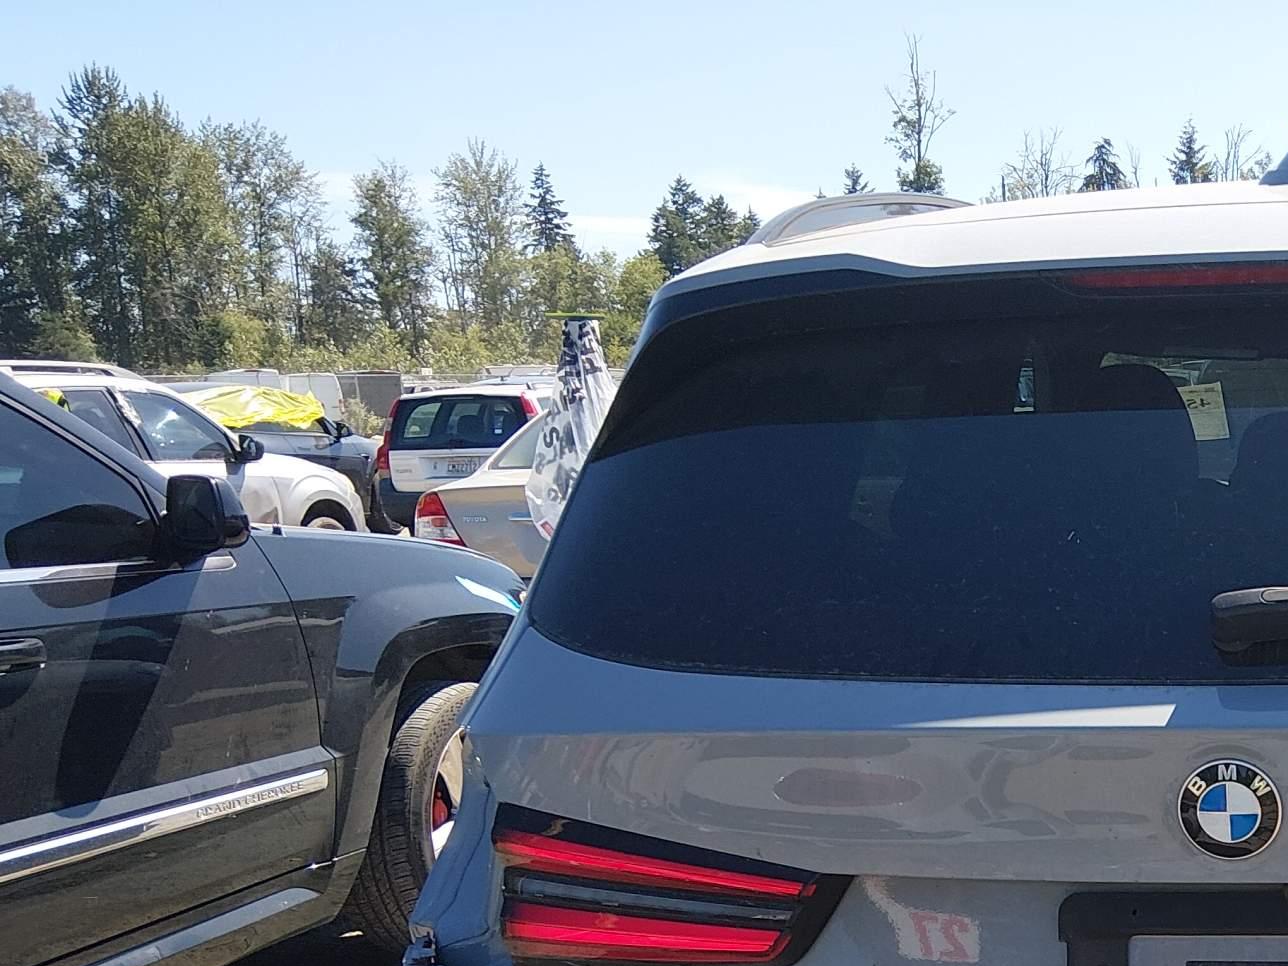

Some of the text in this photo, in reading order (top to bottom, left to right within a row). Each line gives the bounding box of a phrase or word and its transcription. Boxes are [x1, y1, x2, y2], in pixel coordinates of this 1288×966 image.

[1187, 764, 1272, 797] BMW
[196, 780, 305, 819] GRAND CHEROKEE
